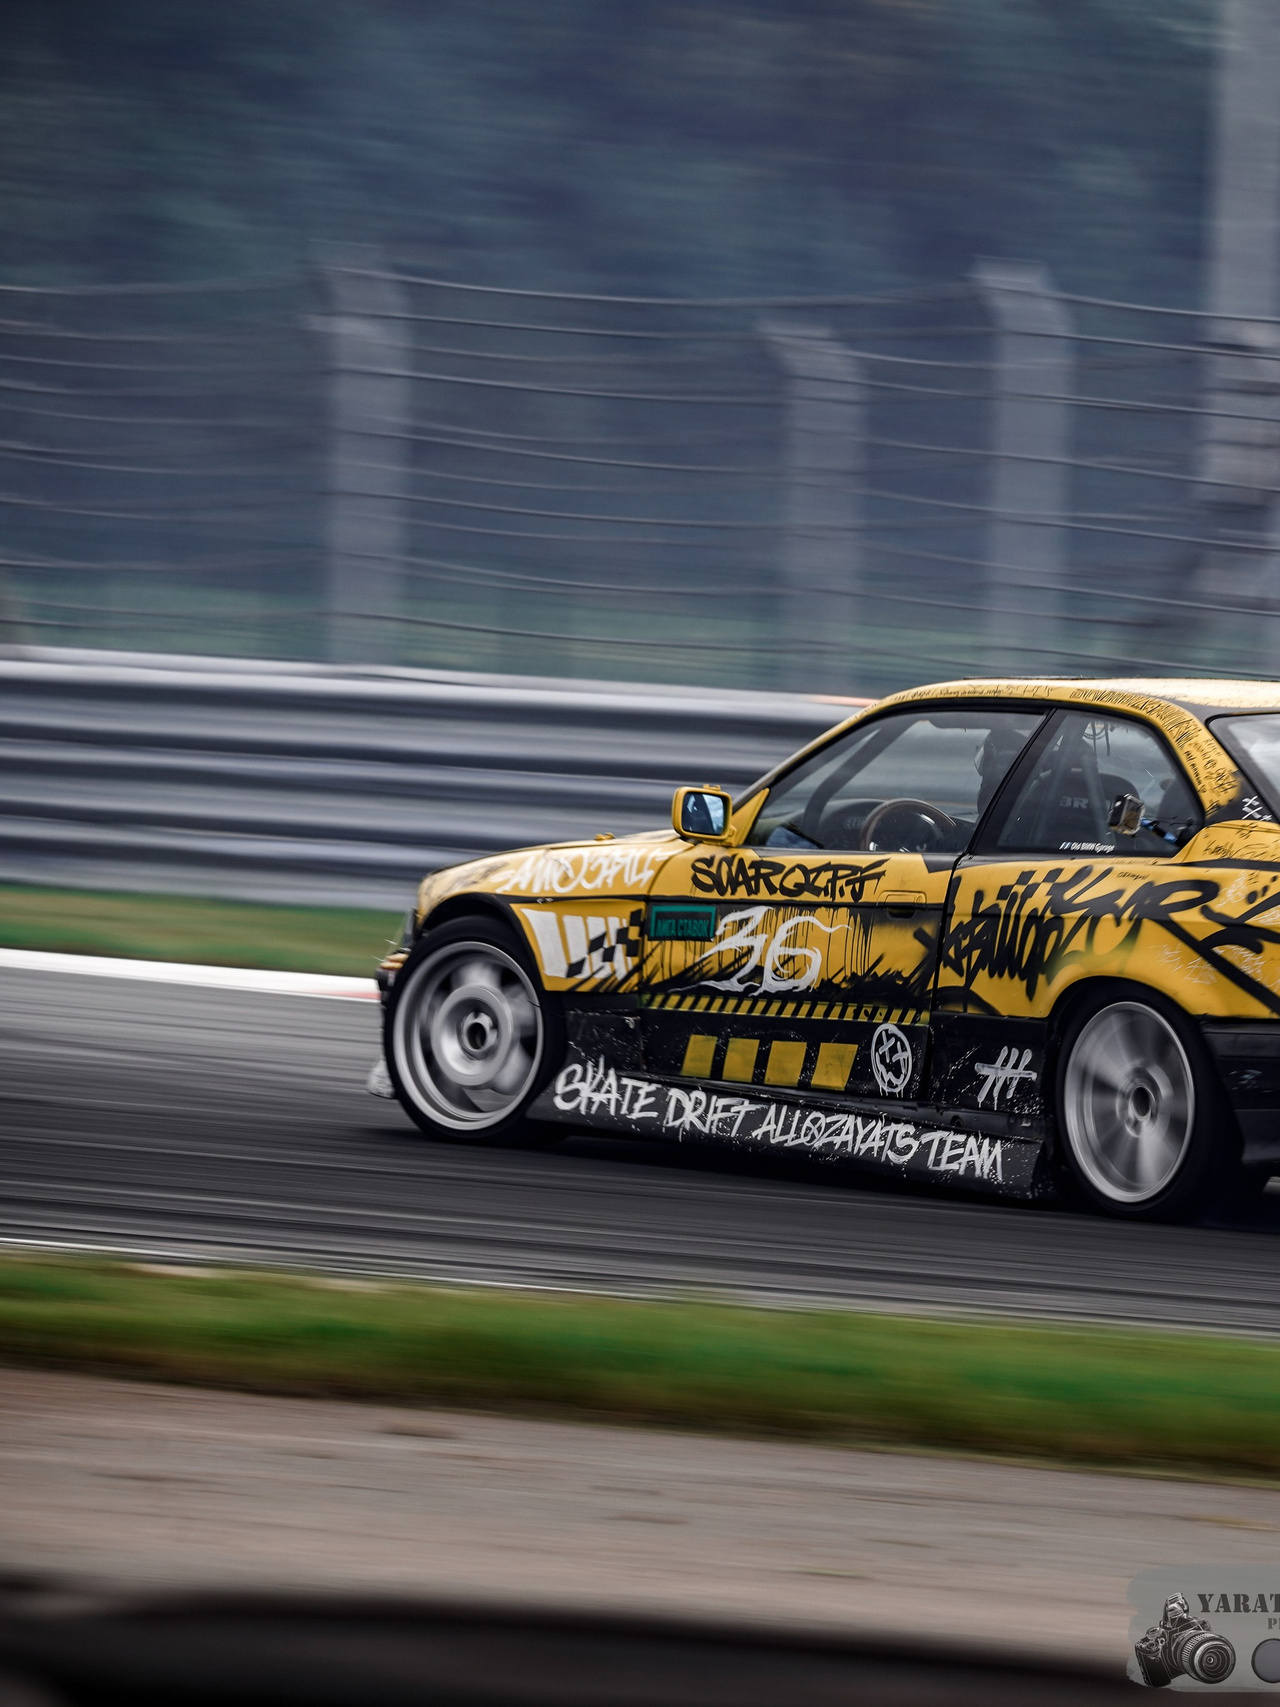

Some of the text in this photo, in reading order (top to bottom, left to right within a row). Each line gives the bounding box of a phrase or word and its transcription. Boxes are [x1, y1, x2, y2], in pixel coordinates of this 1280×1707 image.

[1070, 842, 1115, 853] Old BMW Garage
[668, 905, 852, 996] 36
[553, 1056, 661, 1120] SKATE
[663, 1085, 768, 1139] DRIFT
[920, 1130, 1003, 1182] TEAM
